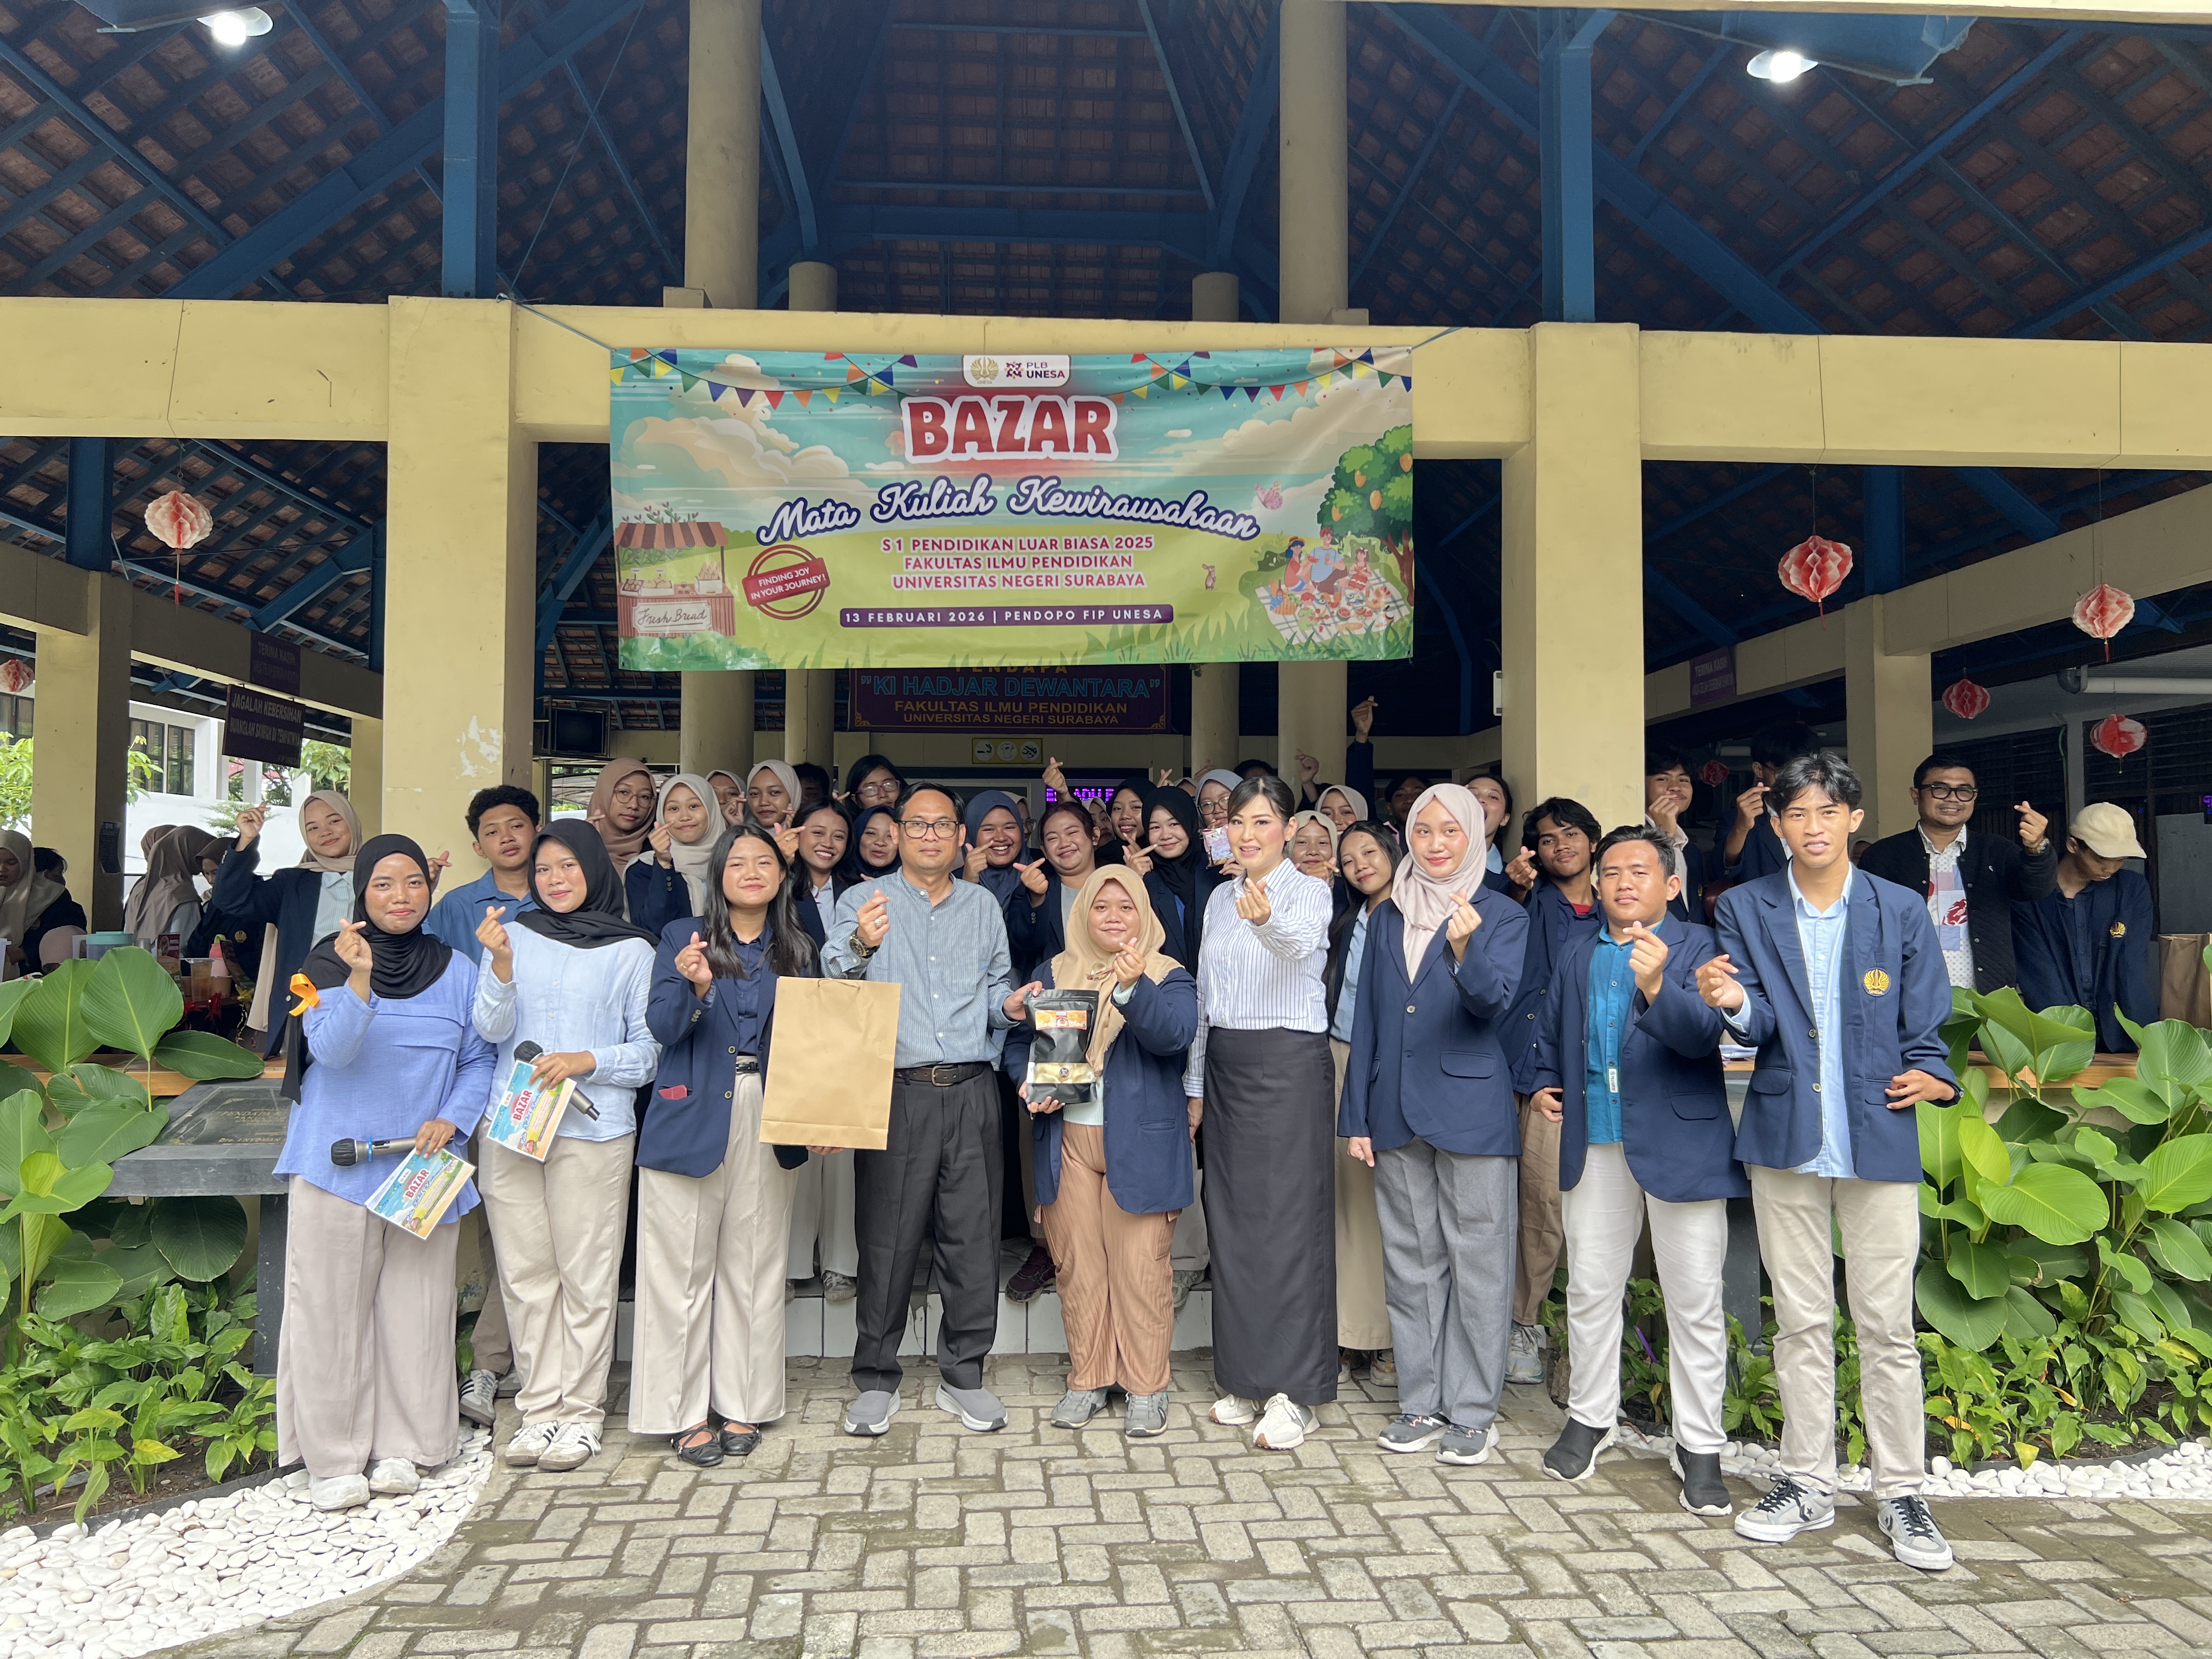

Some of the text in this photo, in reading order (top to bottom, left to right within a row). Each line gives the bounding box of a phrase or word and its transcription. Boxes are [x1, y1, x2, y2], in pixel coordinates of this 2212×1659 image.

[1026, 370, 1065, 379] UNESA
[906, 399, 1114, 458] BAZAR
[759, 475, 1259, 544] Mata Kuliah Kewirausahaan
[912, 539, 1013, 551] PENDIDIKAN
[1019, 538, 1058, 551] LUAR
[1064, 537, 1109, 550] BIASA
[1114, 536, 1153, 549] 2025
[905, 555, 1132, 569] FAKULTAS ILMU PENDIDIKAN
[758, 567, 810, 587] FINDING JOY
[893, 574, 1145, 589] UNIVERSITAS NEGERI SURABAYA
[751, 592, 760, 600] IN
[761, 586, 785, 597] YOUR
[637, 608, 708, 625] Fresh Bread
[845, 613, 860, 623] 13
[868, 612, 941, 623] FEBRUARI
[949, 611, 985, 622] 2026
[1005, 611, 1075, 621] PENDOPO
[1083, 610, 1105, 620] FIP
[1113, 609, 1162, 620] UNESA
[903, 675, 998, 697] HADJAR
[231, 692, 302, 724] JAGALAH KEBERSIHAN
[894, 701, 1128, 713] FAKULTAS ILMU PENDIDIKAN
[904, 713, 1119, 724] UNIVERSITAS NEGERI SURABAYA
[512, 1090, 533, 1121] BAZAR
[404, 1169, 430, 1199] BAZAR
